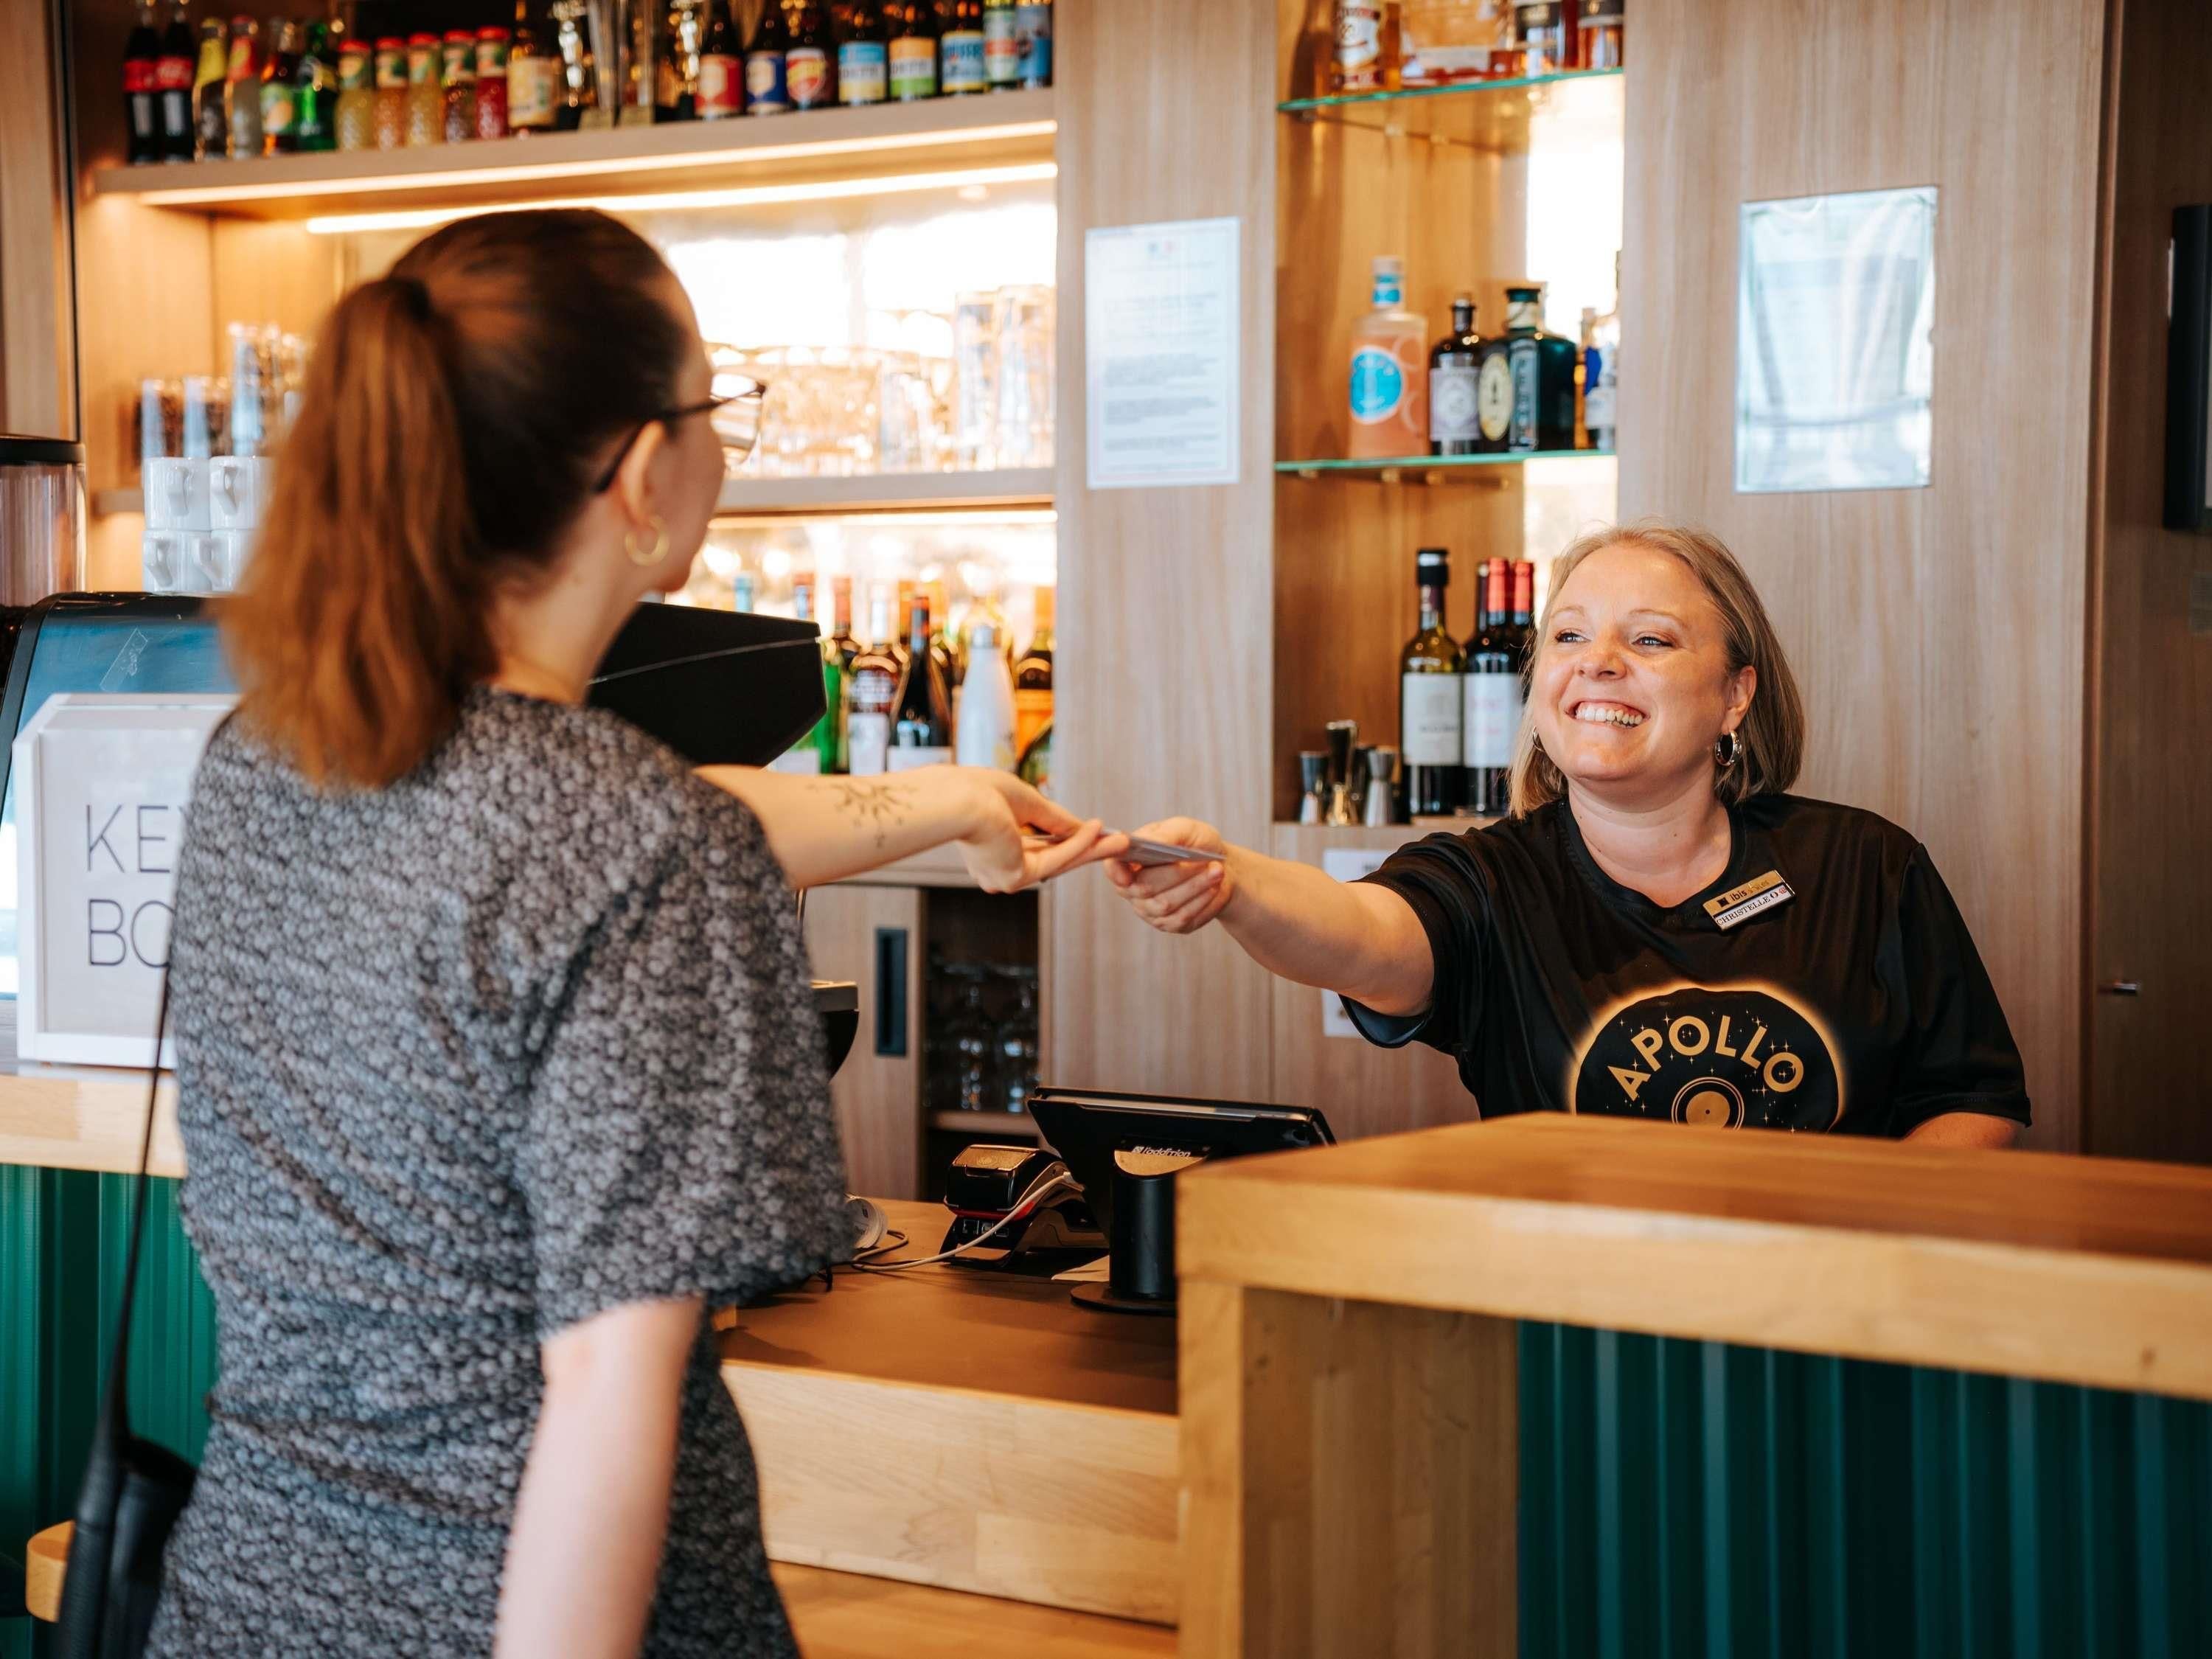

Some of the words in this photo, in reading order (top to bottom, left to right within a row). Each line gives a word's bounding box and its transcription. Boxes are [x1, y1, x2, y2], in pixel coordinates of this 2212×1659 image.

[86, 804, 185, 873] KE
[88, 899, 176, 969] BO
[1717, 896, 1771, 925] CHRISTELLE
[1607, 1015, 1804, 1102] APOLLO
